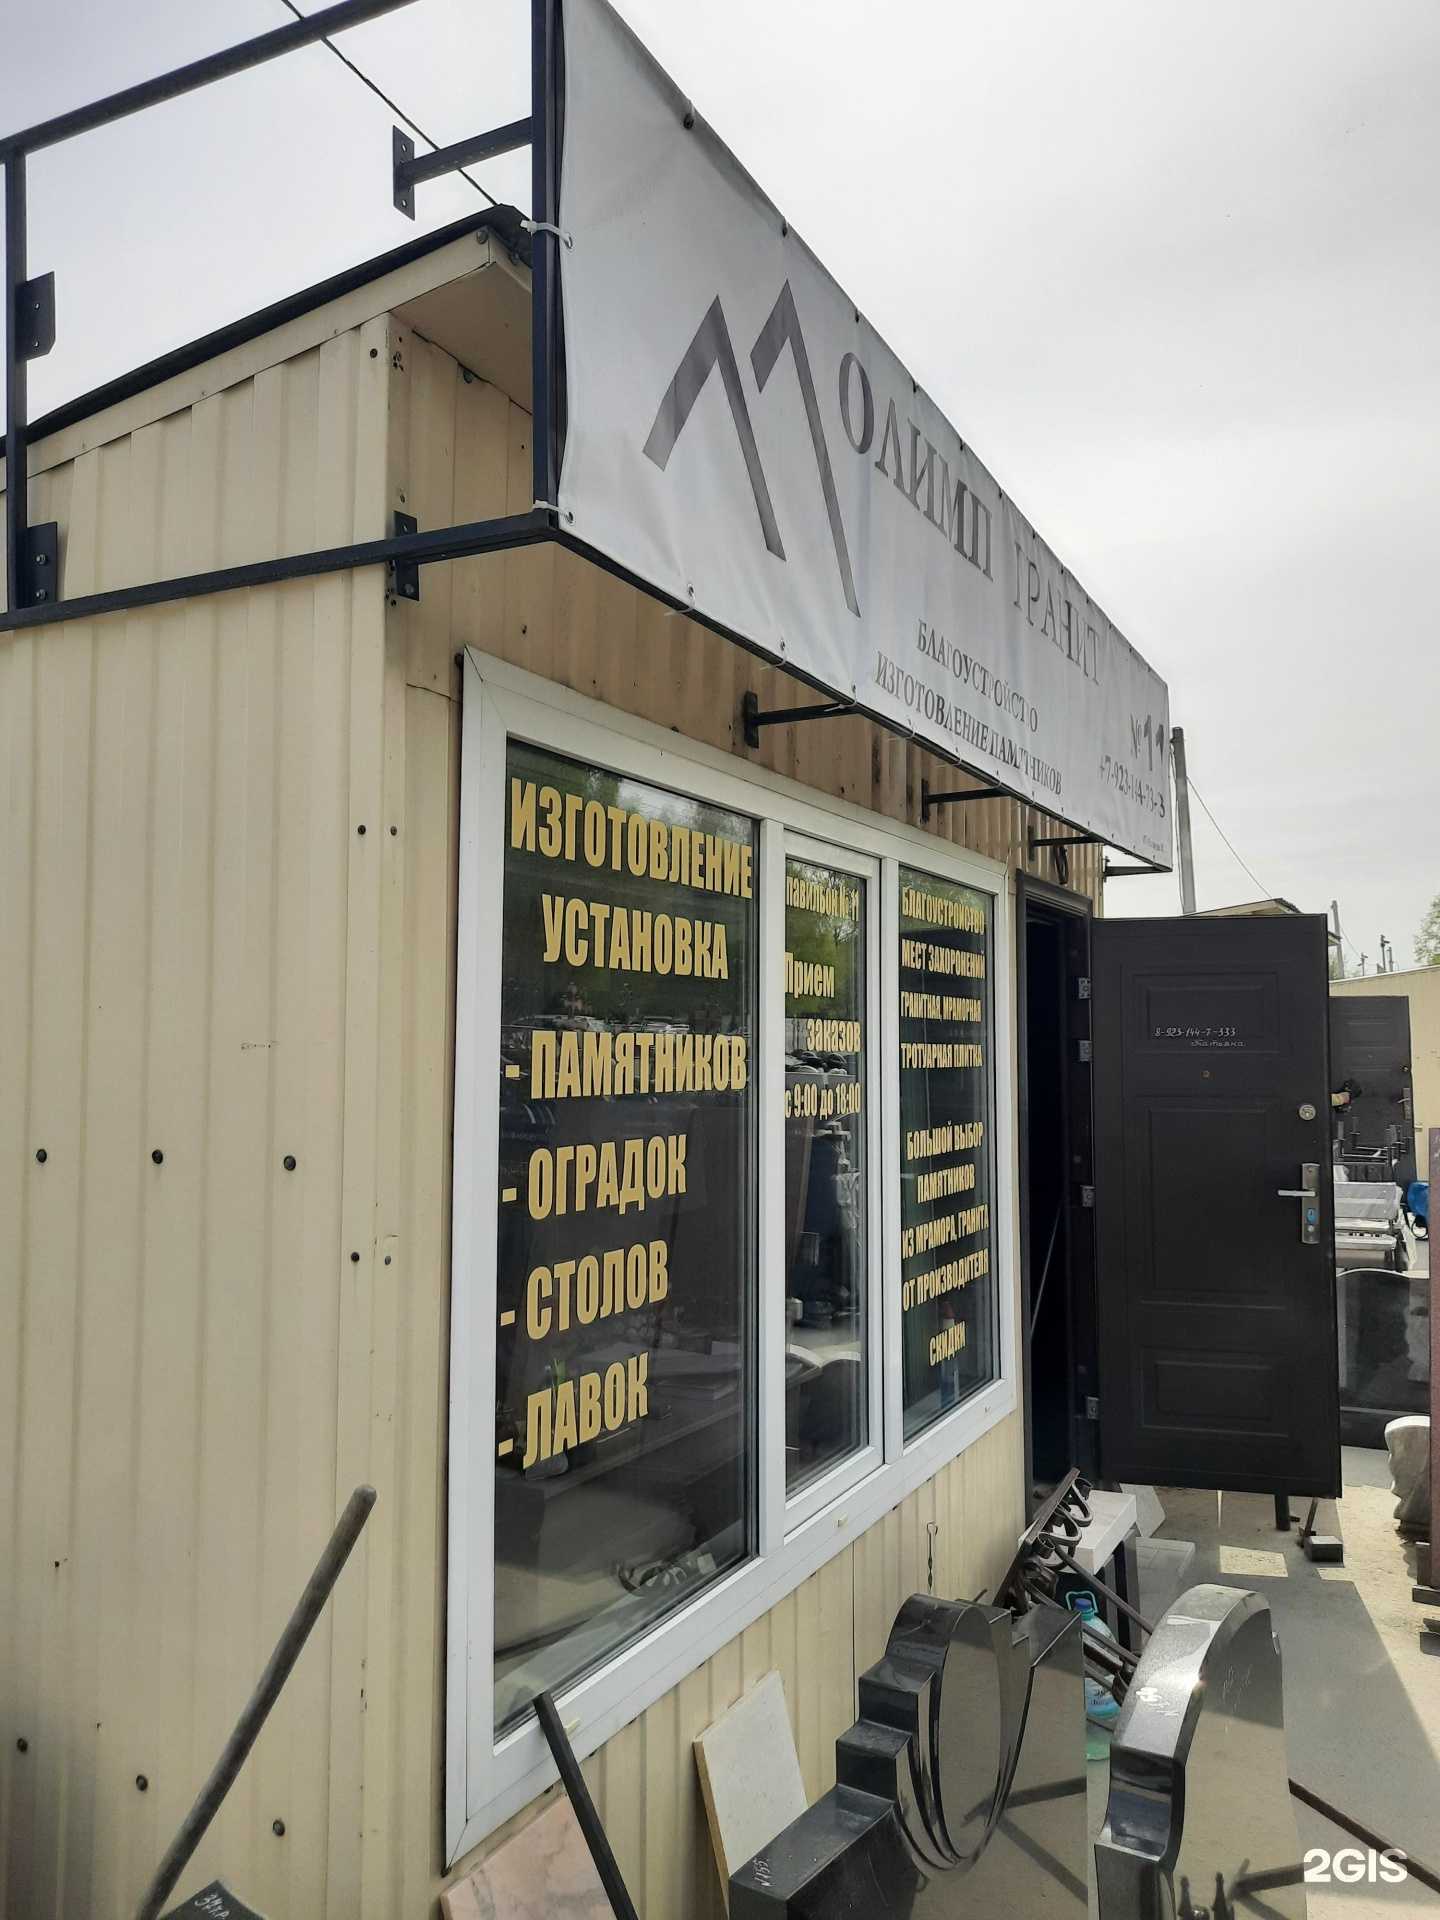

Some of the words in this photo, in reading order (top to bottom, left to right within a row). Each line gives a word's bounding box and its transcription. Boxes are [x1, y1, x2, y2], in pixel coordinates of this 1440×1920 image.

[838, 352, 994, 582] ОЛИМП
[511, 777, 752, 899] ИЗГОТОВЛЕНИЕ
[541, 893, 729, 980] УСТАНОВКА
[902, 938, 927, 970] МЕСТ
[785, 951, 834, 999] Прием
[806, 1018, 861, 1052] заказов
[900, 1042, 952, 1069] ТРОТУАРНАЯ
[793, 1083, 818, 1118] 9:00
[819, 1088, 834, 1121] до
[835, 1082, 861, 1115] 18:00
[907, 1120, 953, 1160] БОЛЬШОЙ
[954, 1121, 984, 1150] ВЫБОР
[917, 1163, 976, 1204] ПАМЯТНИКОВ
[902, 1227, 915, 1260] ИЗ
[958, 1203, 990, 1239] ГРАНИТА
[902, 1278, 916, 1312] ОТ
[916, 1247, 989, 1305] ПРОИЗВОДИТЕЛЯ
[929, 1320, 966, 1367] СКИДКИ
